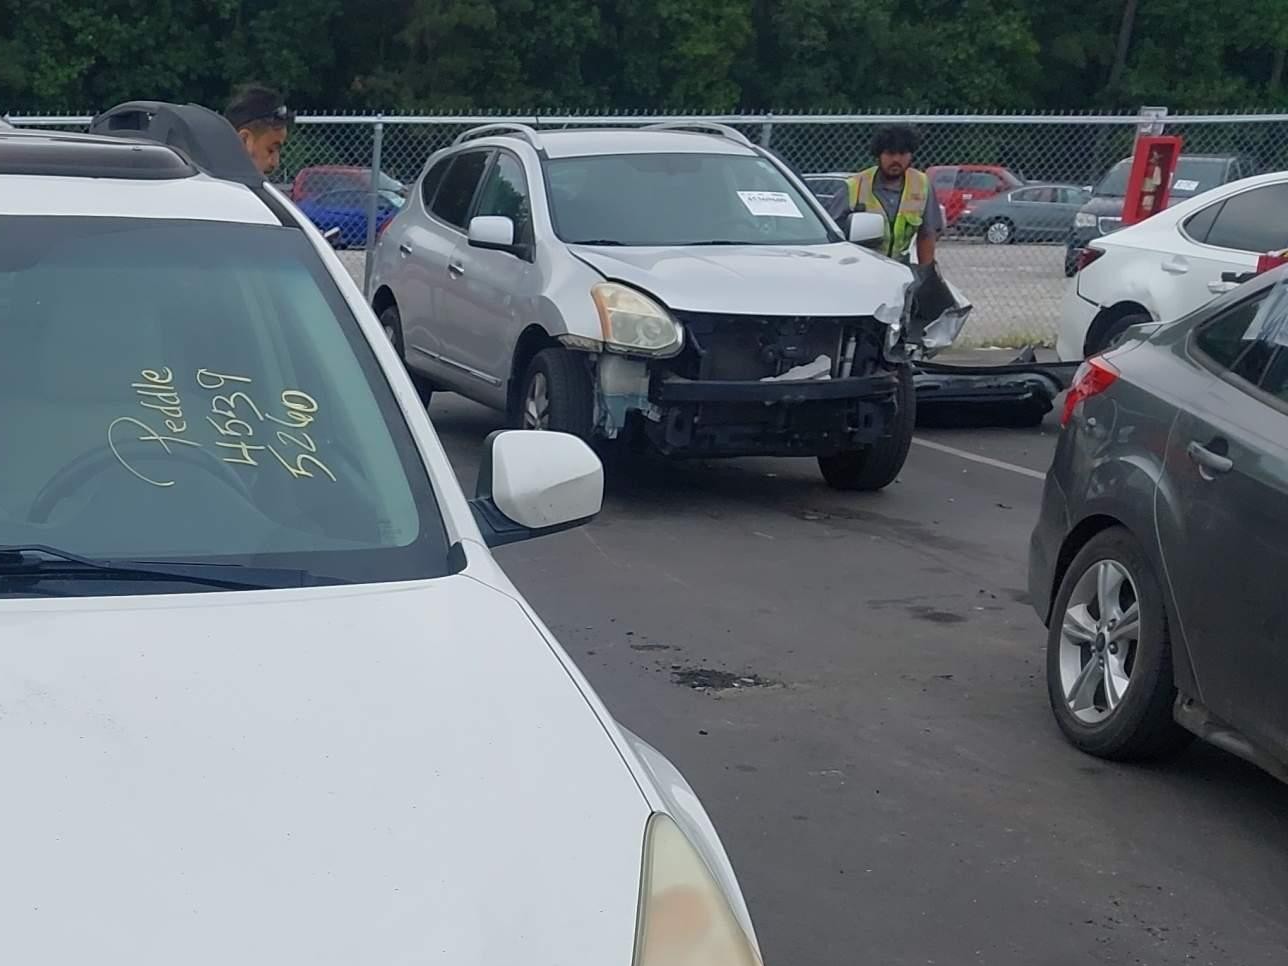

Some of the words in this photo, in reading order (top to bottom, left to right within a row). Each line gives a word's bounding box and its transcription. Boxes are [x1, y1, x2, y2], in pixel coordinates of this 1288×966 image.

[108, 366, 202, 486] Peddle
[196, 368, 266, 466] 4539
[265, 390, 337, 482] 5260
